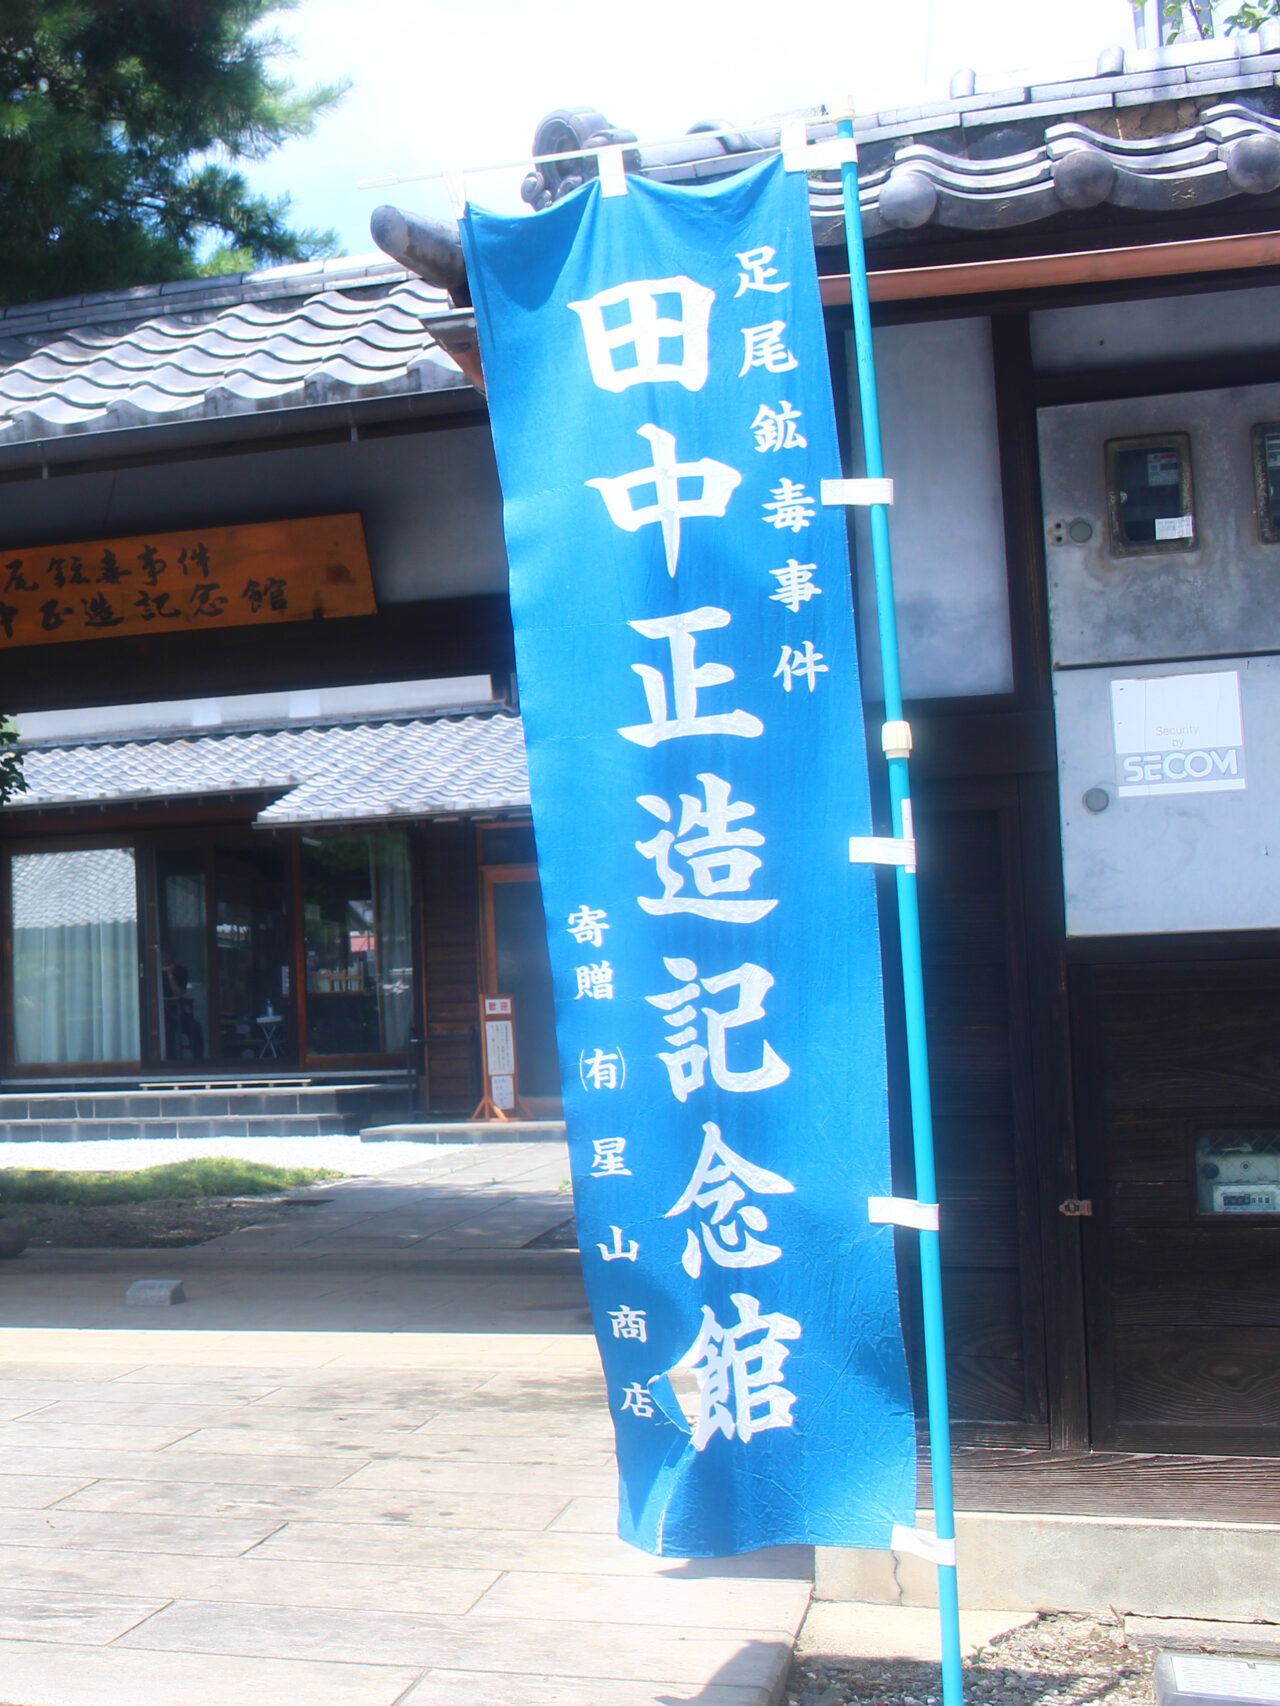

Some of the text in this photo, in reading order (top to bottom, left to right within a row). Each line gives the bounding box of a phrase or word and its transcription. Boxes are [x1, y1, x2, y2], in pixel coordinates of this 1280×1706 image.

[733, 245, 829, 693] 足尾鉱毒事件
[1155, 725, 1200, 737] Security
[1171, 738, 1185, 749] by
[1123, 749, 1239, 782] SECOM
[567, 274, 803, 1452] 田中正造記念館
